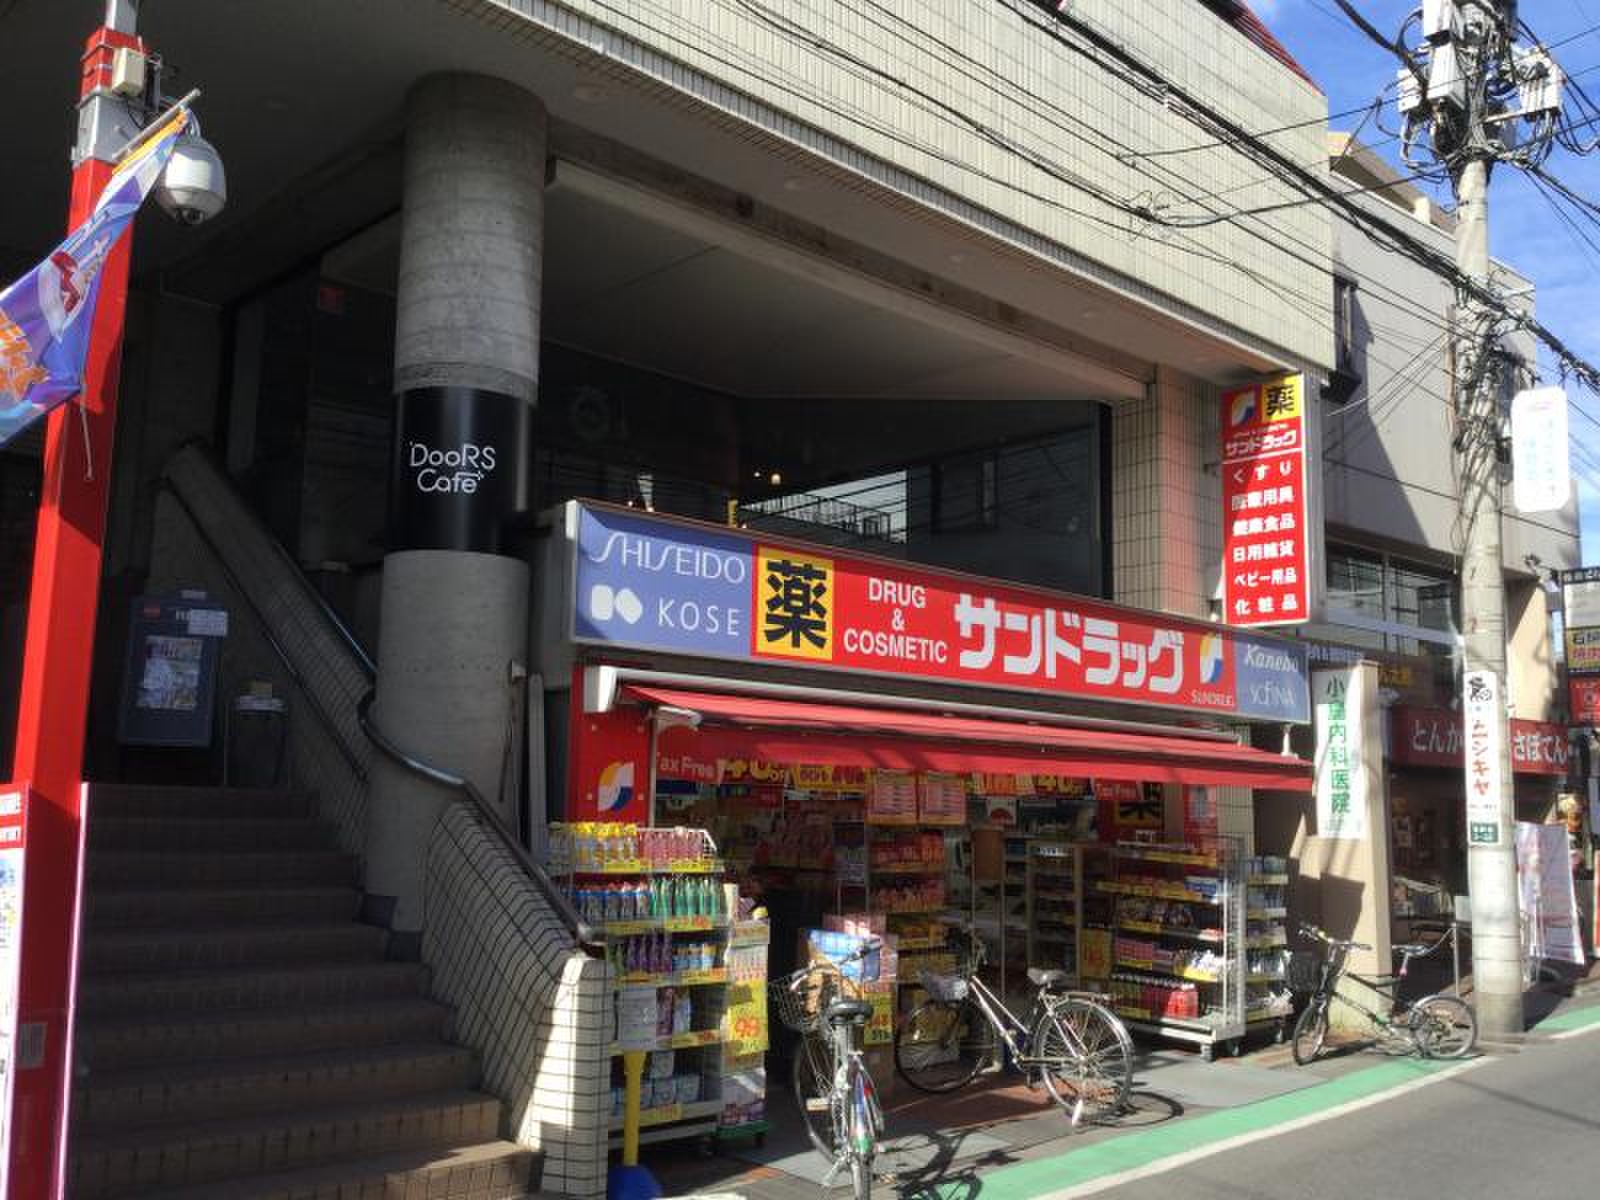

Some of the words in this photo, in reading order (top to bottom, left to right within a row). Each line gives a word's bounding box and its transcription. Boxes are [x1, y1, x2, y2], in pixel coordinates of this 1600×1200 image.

[1267, 384, 1295, 416] 薬
[1225, 430, 1297, 457] サンドラッグ
[1233, 461, 1292, 483] くすり
[591, 532, 746, 584] SHISEIDO
[868, 577, 927, 609] DRUG
[1234, 567, 1297, 588] ベビー用品
[657, 597, 741, 637] KOSE
[764, 558, 827, 649] 薬
[1234, 593, 1298, 616] 化粧品
[892, 609, 906, 631] &
[843, 628, 948, 664] COSMETIC
[954, 593, 1185, 695] サンドラッグ
